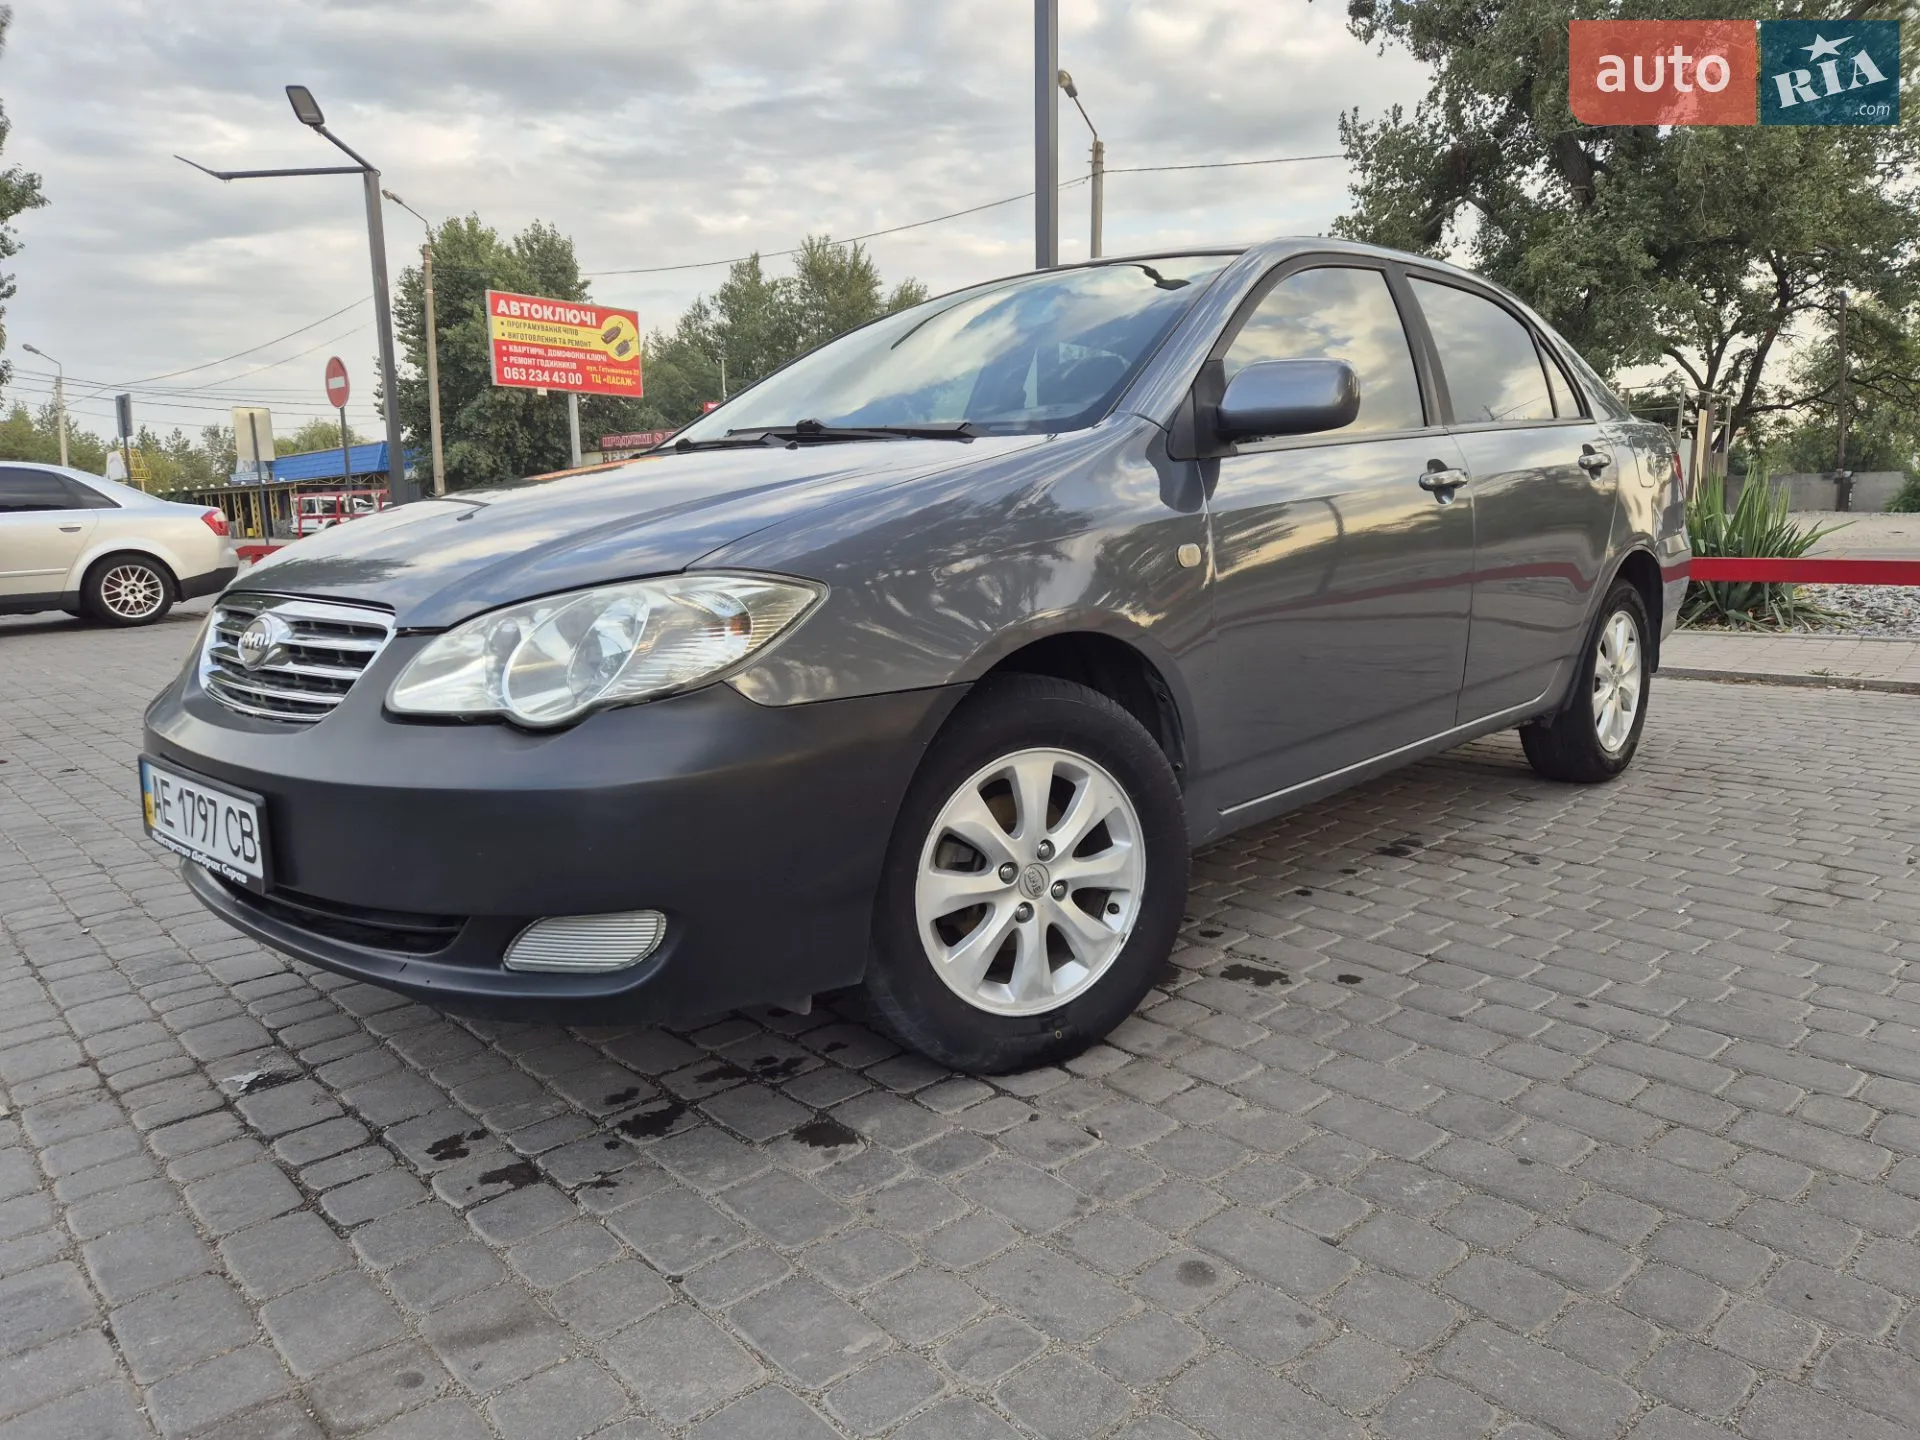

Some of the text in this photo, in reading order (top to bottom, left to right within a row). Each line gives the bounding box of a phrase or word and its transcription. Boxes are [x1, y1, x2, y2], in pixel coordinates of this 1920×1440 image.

[497, 299, 597, 326] АВТОКЛЮЧІ
[507, 320, 562, 334] ПРОГРАМУВАННЯ
[508, 332, 558, 344] ВИГОТОВЛЕННЯ
[567, 339, 592, 347] РЕМОНТ
[509, 356, 536, 366] РЕМОНТ
[503, 366, 583, 386] 063 234 43 00
[591, 373, 602, 384] ТЦ
[153, 775, 257, 864] AE 1797 CB
